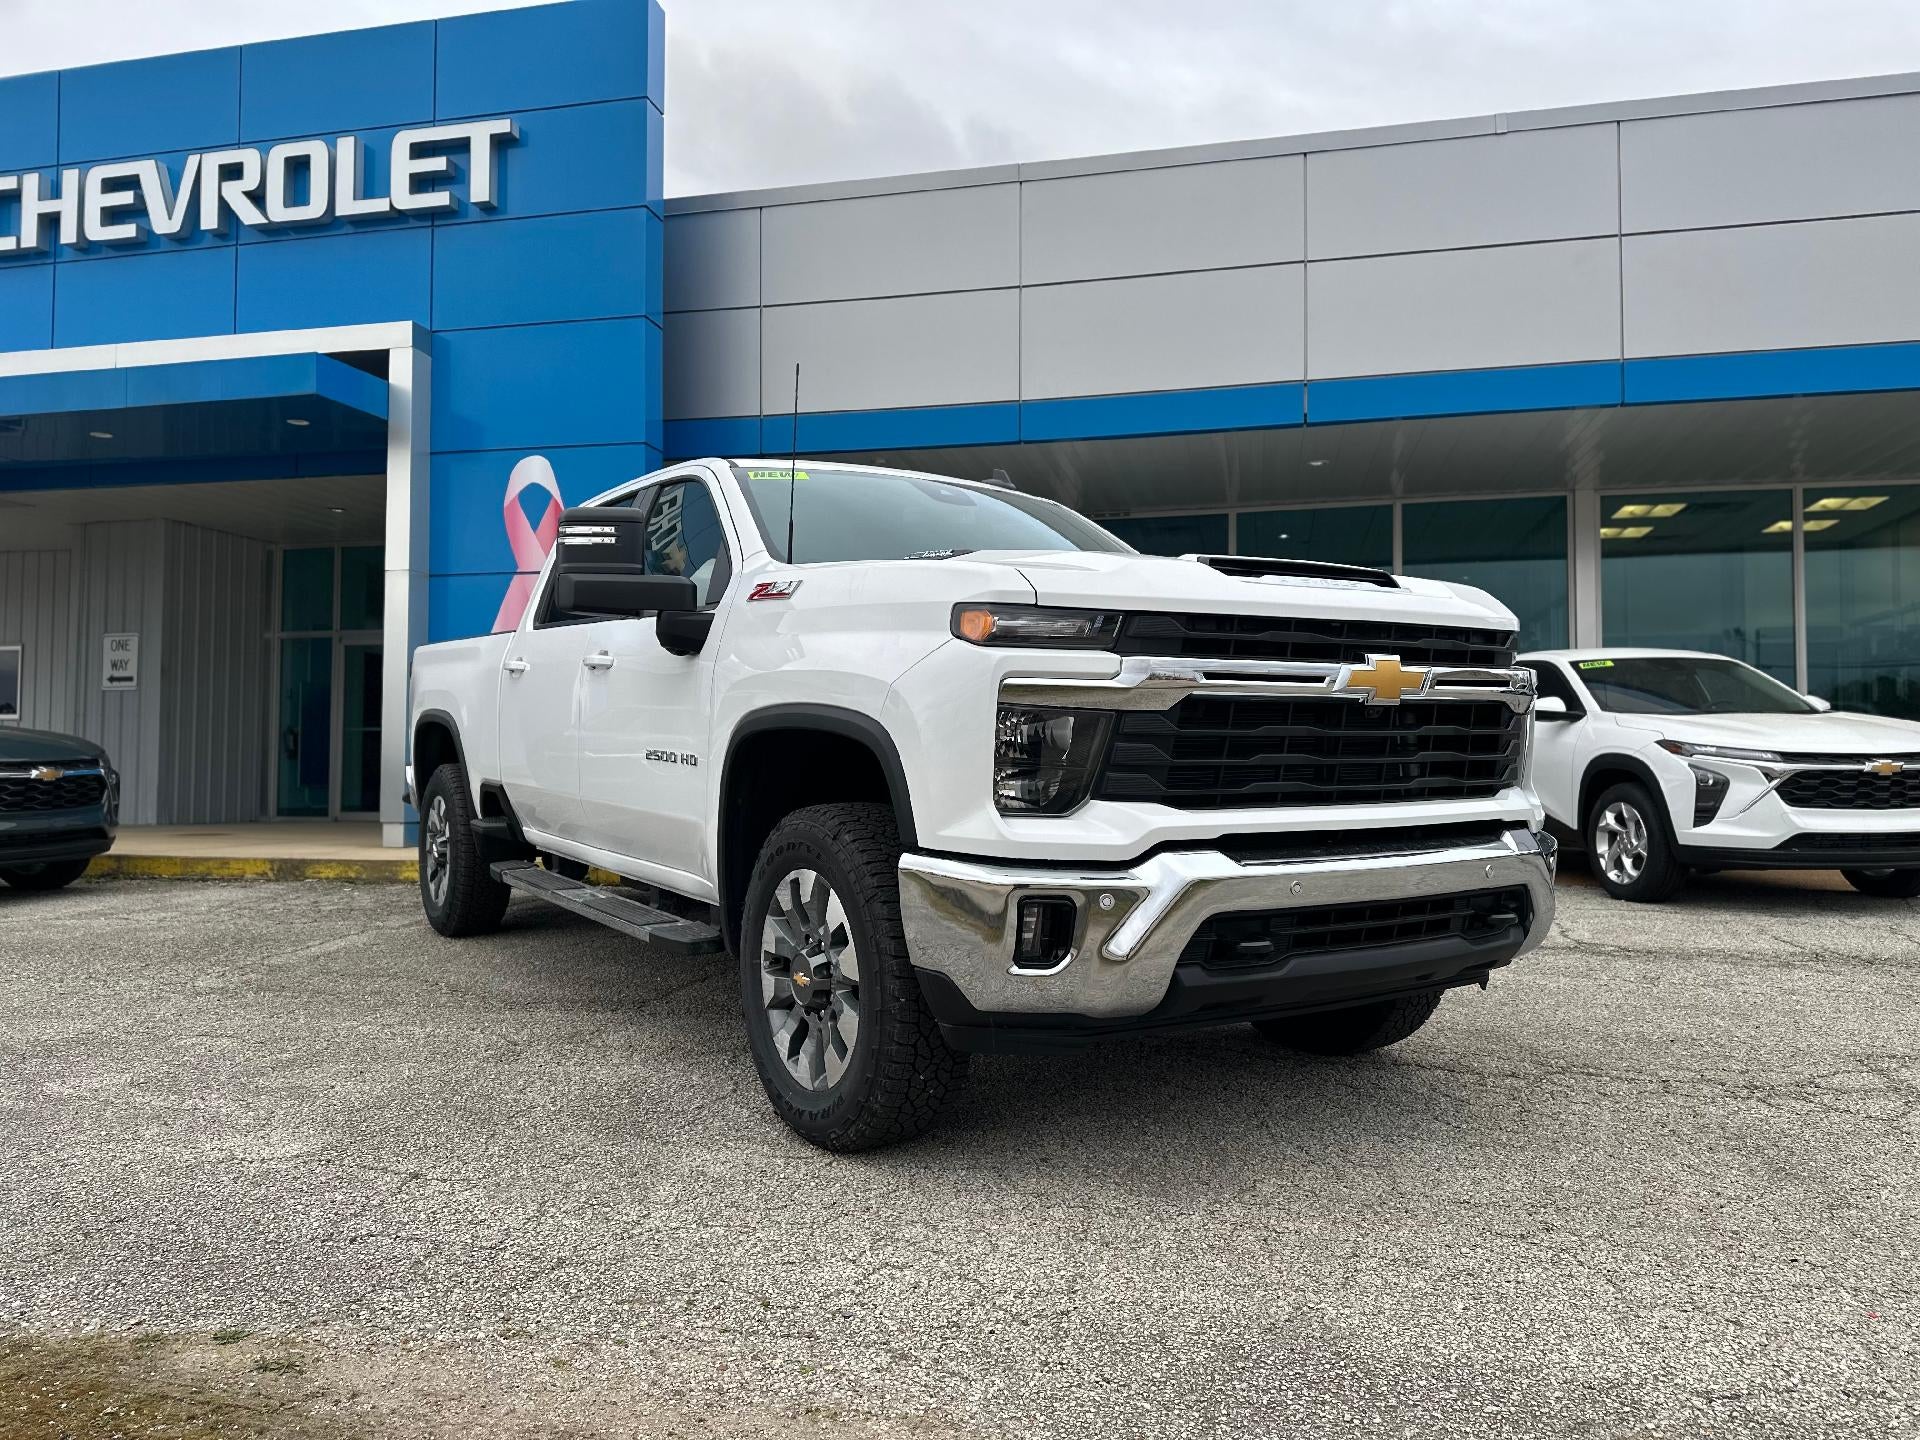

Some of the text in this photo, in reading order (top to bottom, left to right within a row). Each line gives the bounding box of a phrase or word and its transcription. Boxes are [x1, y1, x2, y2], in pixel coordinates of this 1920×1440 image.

[752, 471, 799, 480] NEW
[111, 639, 131, 652] ONE
[110, 658, 130, 673] WAY
[645, 749, 699, 767] 2500 HD
